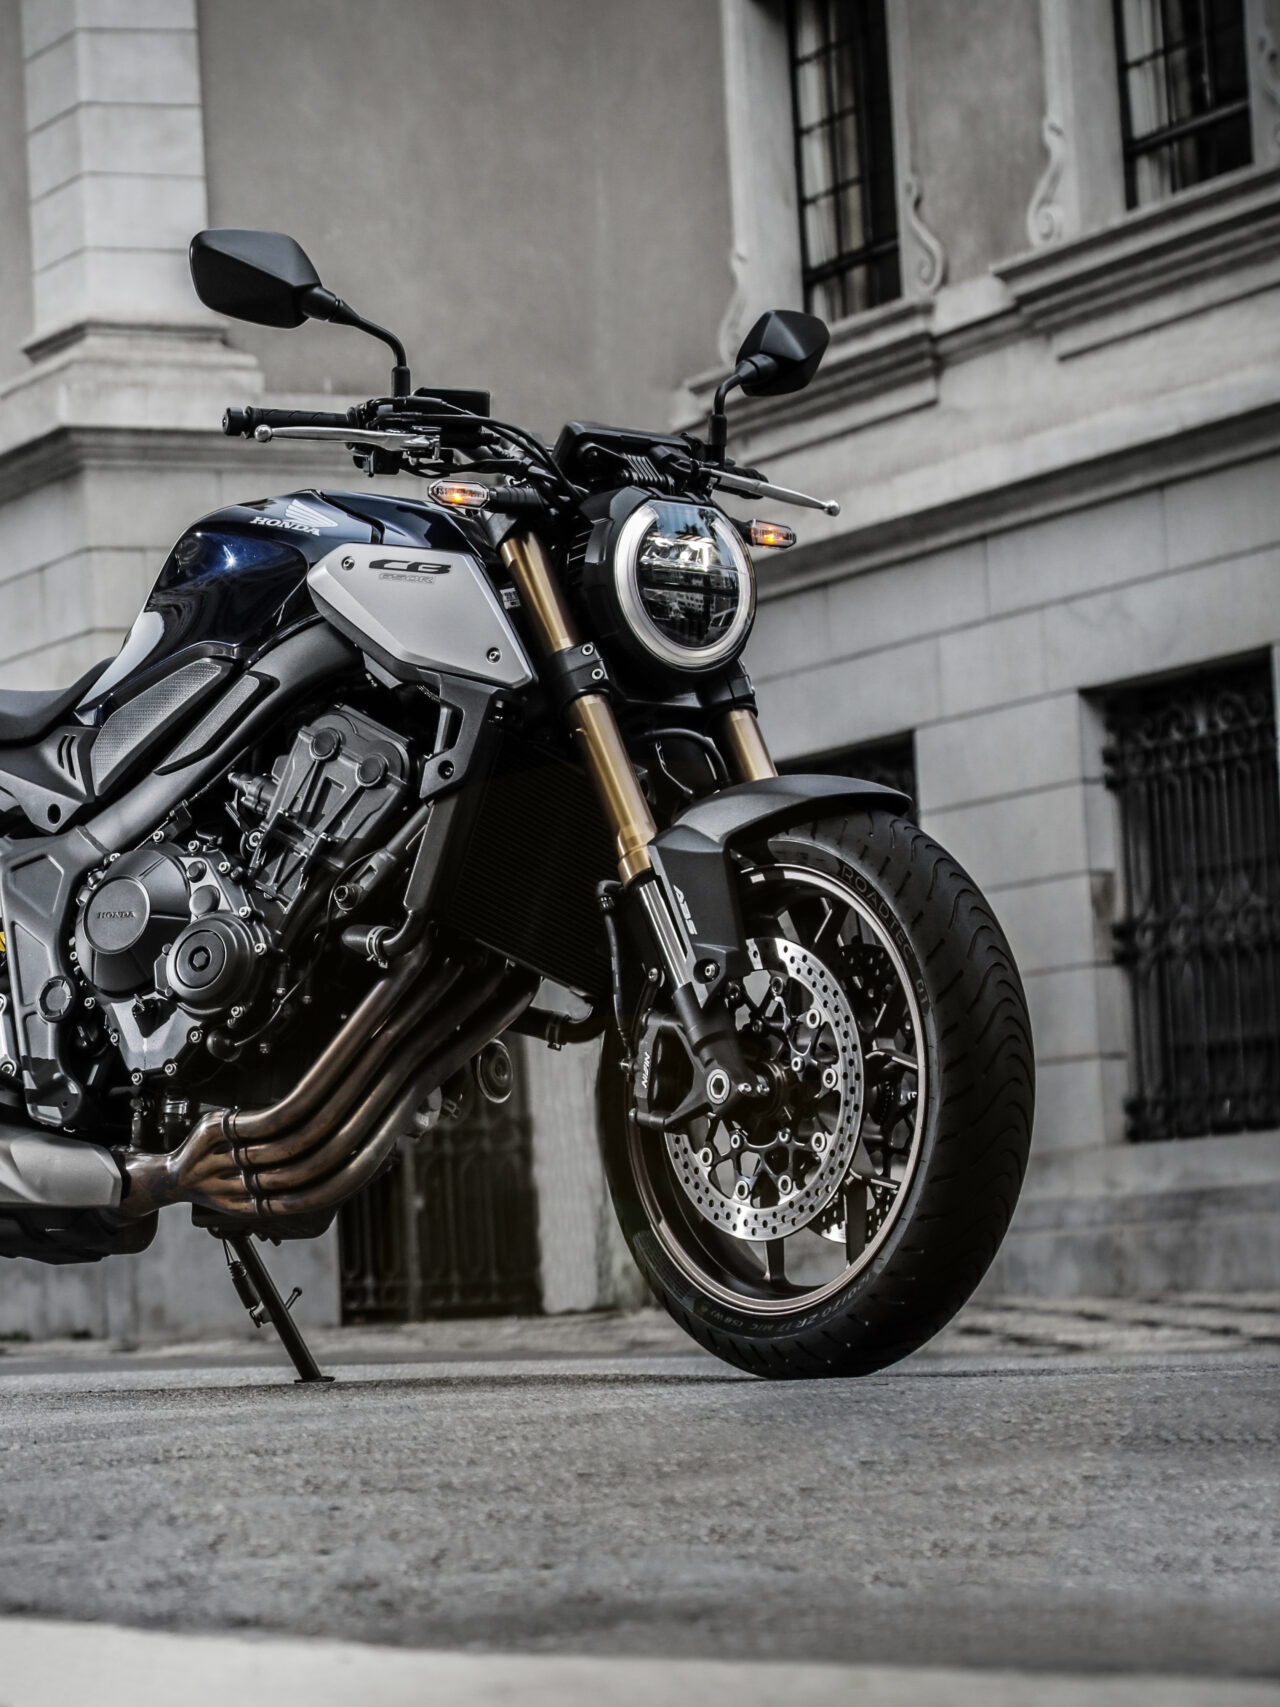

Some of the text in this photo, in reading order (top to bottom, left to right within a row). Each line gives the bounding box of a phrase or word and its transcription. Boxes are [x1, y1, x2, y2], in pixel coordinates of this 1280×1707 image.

[249, 516, 320, 537] HONDA
[368, 559, 451, 575] CB
[96, 910, 137, 919] HONDA
[673, 884, 698, 936] ABS
[841, 865, 914, 961] ROADTEC
